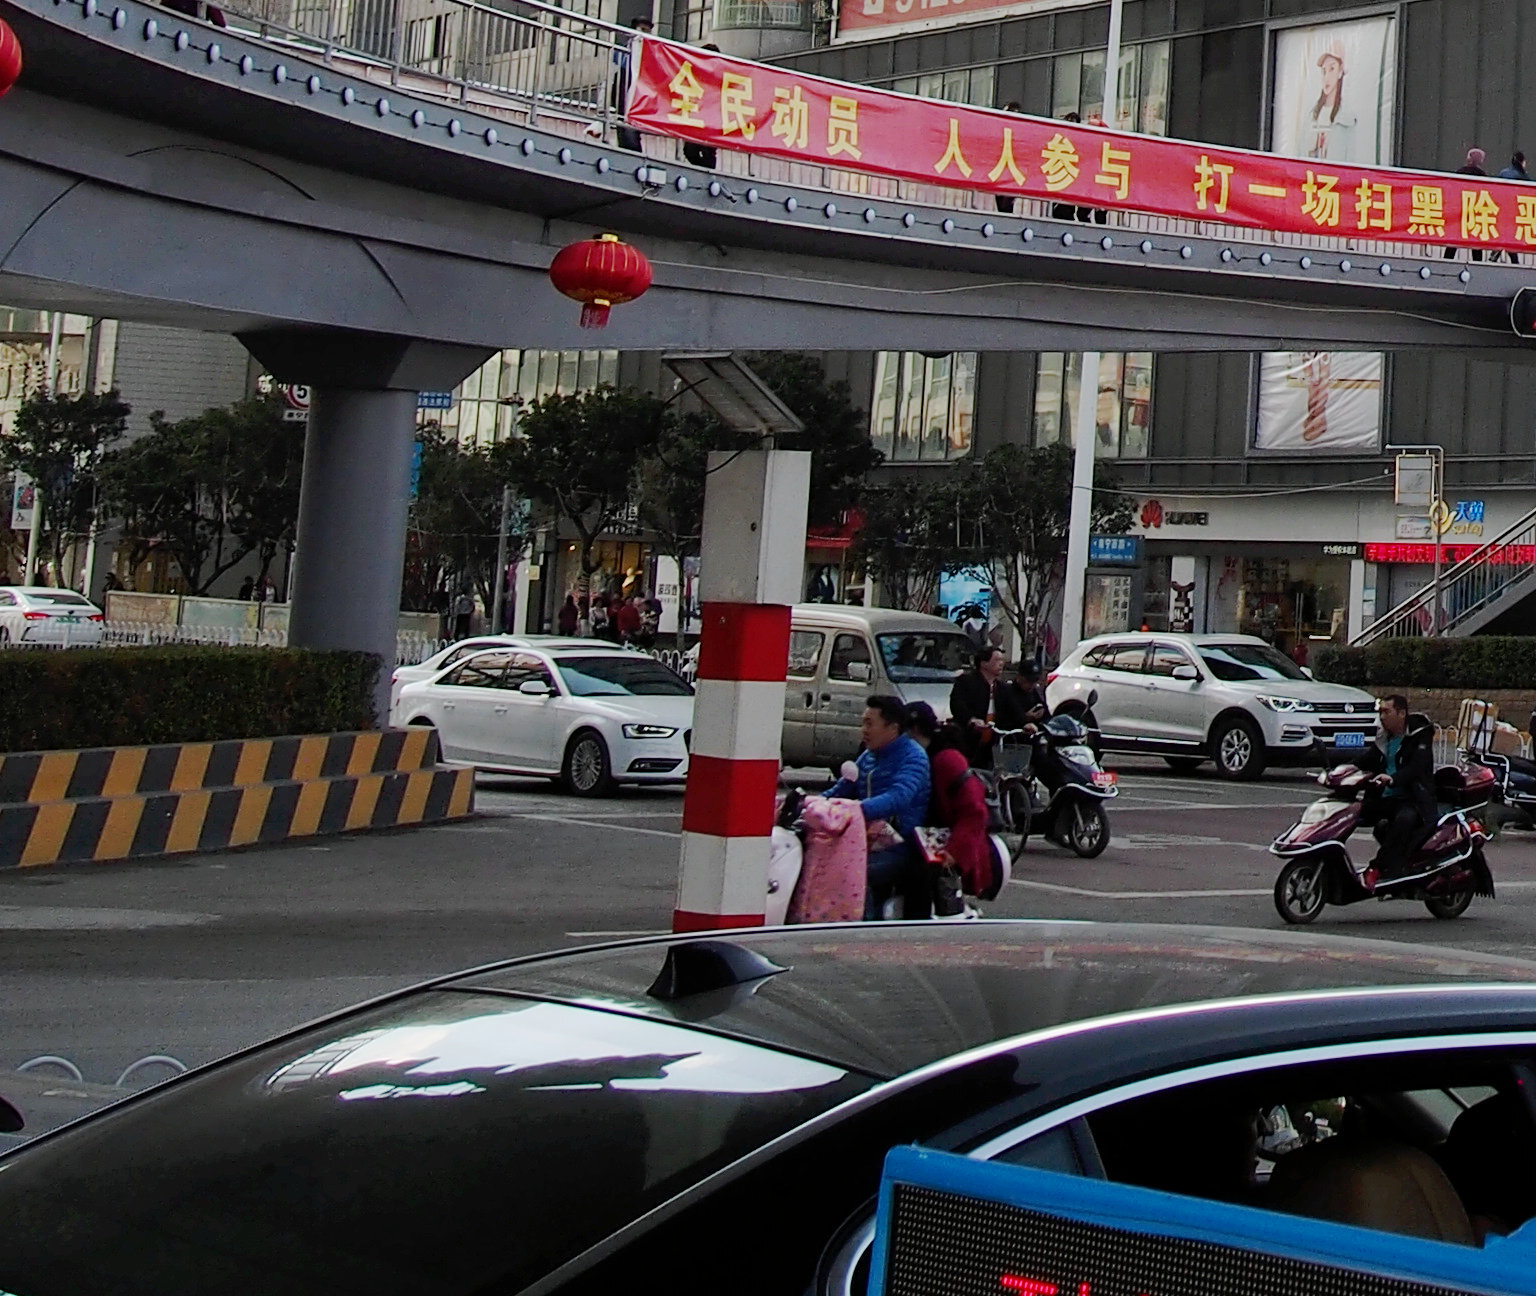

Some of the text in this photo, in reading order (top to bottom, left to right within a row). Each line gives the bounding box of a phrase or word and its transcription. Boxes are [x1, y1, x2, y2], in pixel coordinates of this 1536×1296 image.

[667, 60, 863, 160] 全民动员
[933, 117, 1132, 201] 人人参与
